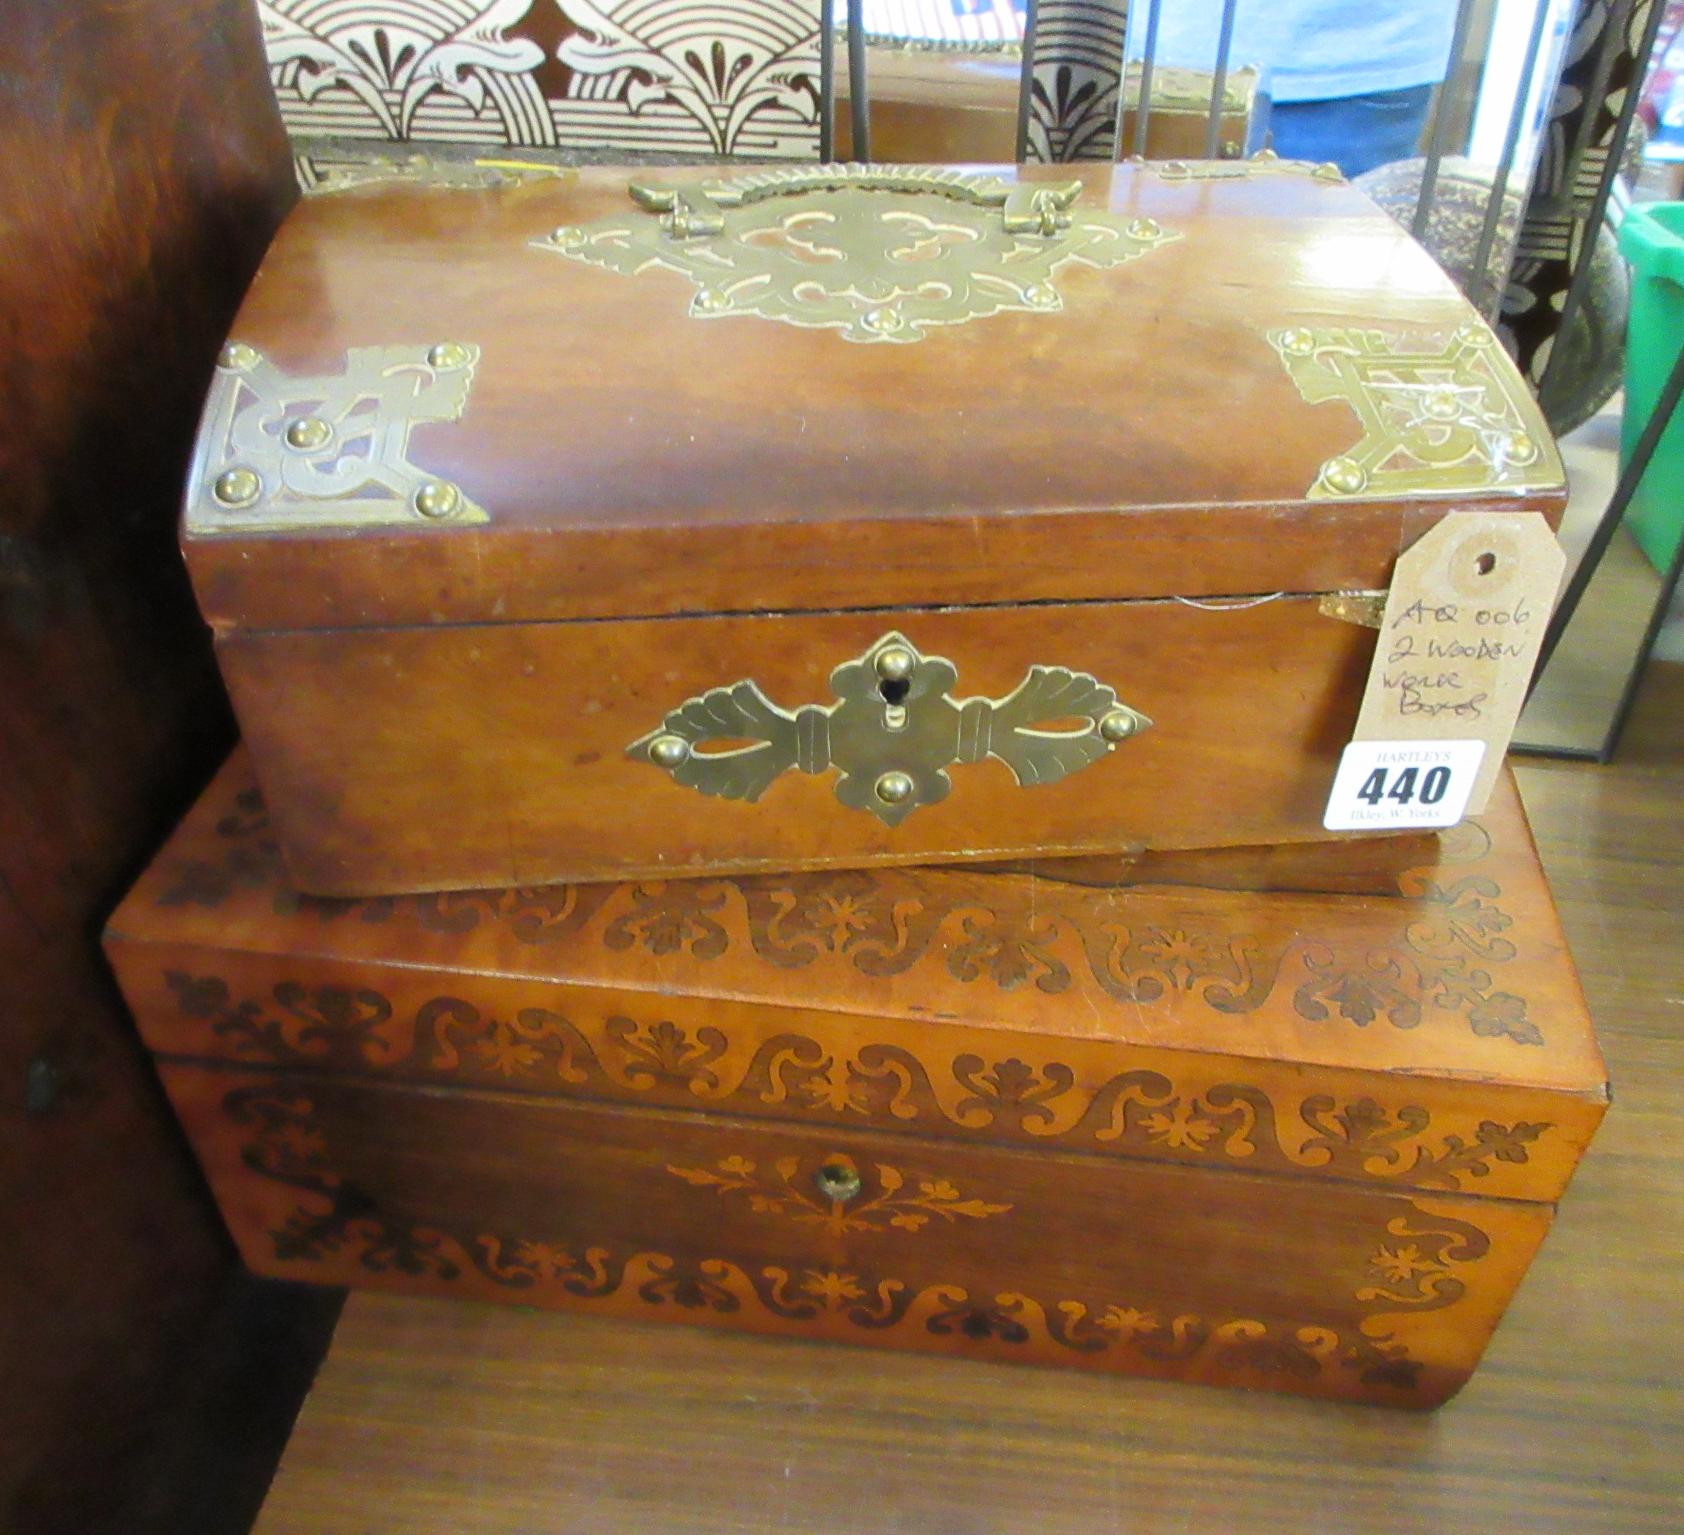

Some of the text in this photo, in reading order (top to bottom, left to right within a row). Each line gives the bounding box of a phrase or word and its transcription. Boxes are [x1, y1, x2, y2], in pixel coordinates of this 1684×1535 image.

[1475, 597, 1531, 626] 006
[1388, 635, 1420, 664] 2
[1376, 751, 1452, 764] HARTLEYS
[1356, 765, 1452, 806] 440
